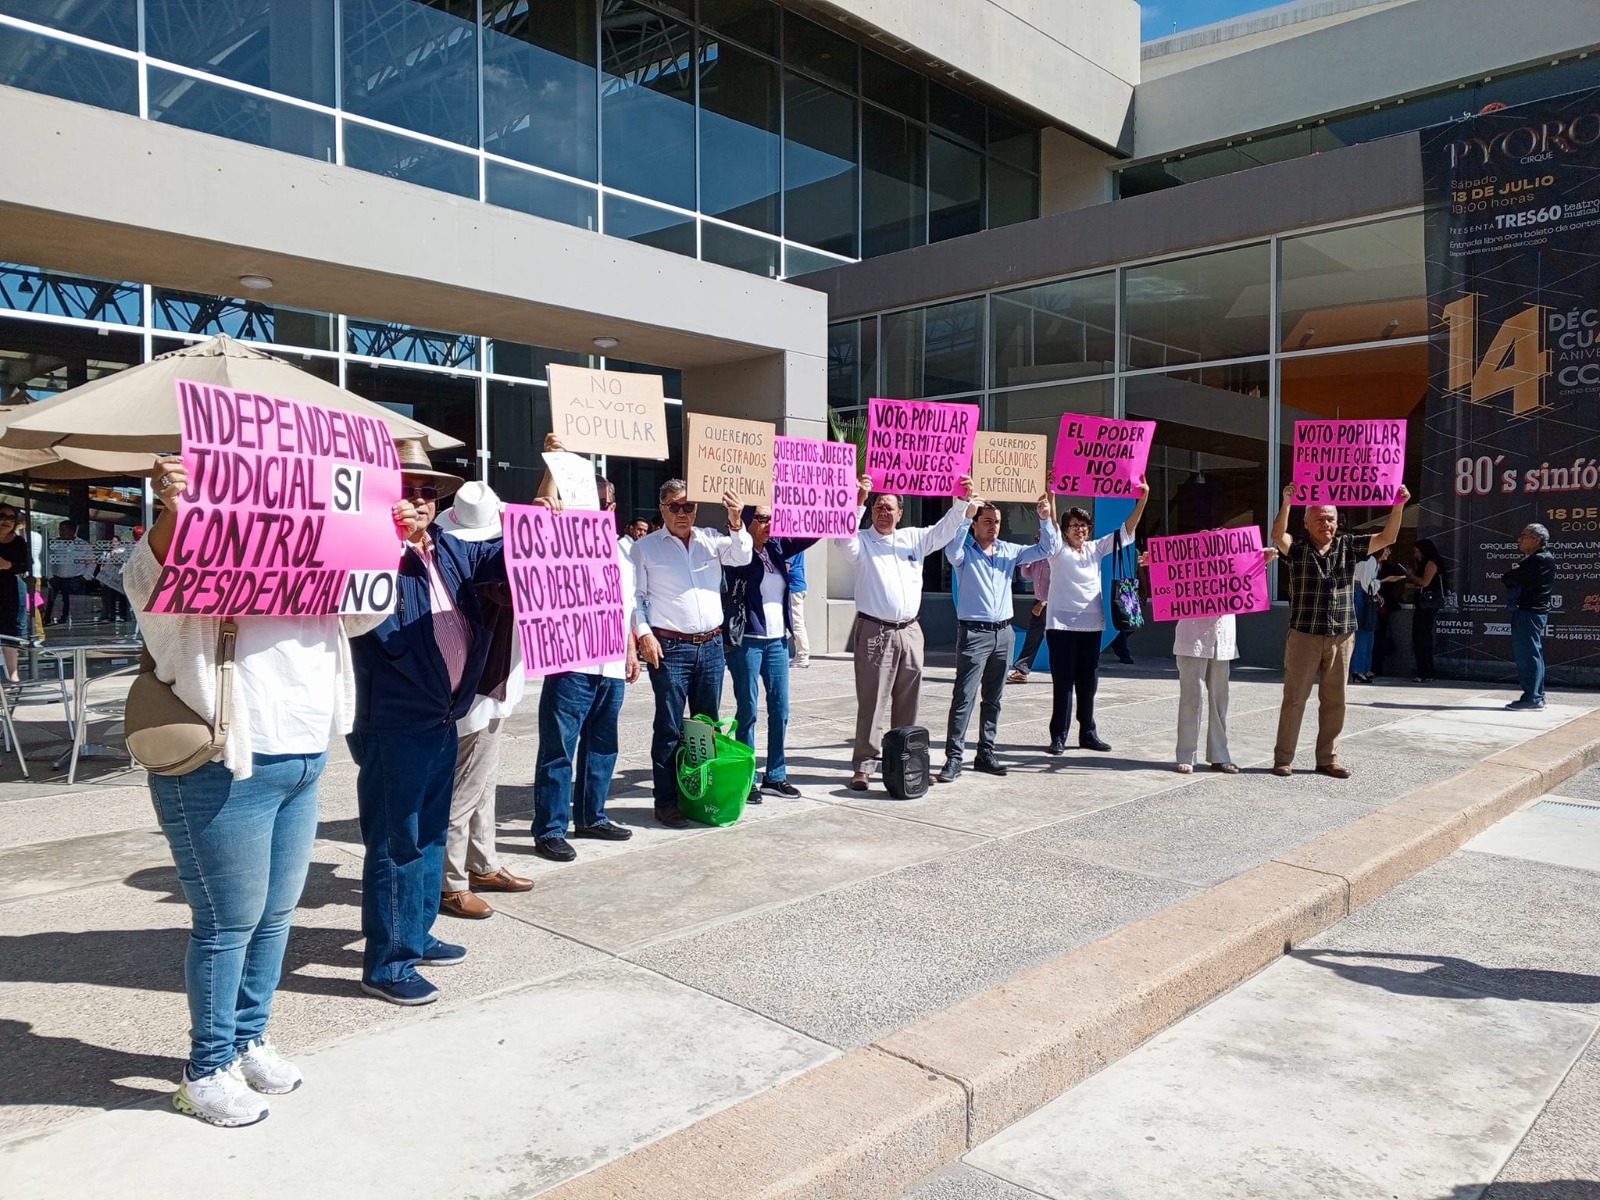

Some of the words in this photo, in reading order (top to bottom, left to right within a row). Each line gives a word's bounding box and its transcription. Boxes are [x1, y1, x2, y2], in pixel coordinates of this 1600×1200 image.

[1520, 152, 1554, 164] CIRQUE
[1451, 175, 1498, 189] Sábado
[1472, 186, 1494, 200] DE
[1499, 175, 1555, 194] JULIO
[1452, 202, 1487, 214] 19:00
[1491, 192, 1535, 208] horas
[1563, 206, 1600, 218] musical
[1450, 224, 1494, 235] PRESENTA
[1495, 205, 1562, 230] TRES60
[1563, 199, 1600, 212] teatro
[1450, 237, 1482, 248] Entrada
[1484, 234, 1503, 244] libre
[1504, 231, 1522, 240] con
[1556, 224, 1568, 232] de
[1558, 330, 1600, 350] CU
[1442, 294, 1546, 415] 14
[591, 376, 622, 394] NO
[570, 397, 594, 409] AL
[599, 400, 646, 414] VOTO
[179, 382, 399, 470] INDEPENDENCIA
[565, 414, 656, 442] POPULAR
[875, 404, 908, 430] VOTO
[911, 407, 968, 435] POPULAR
[704, 426, 763, 446] QUEREMOS
[872, 430, 892, 449] NO
[944, 436, 966, 454] QUE
[1068, 422, 1084, 438] EL
[1097, 425, 1144, 442] PODER
[1298, 424, 1333, 444] VOTO
[1337, 424, 1400, 446] POPULAR
[774, 440, 818, 463] QUEREMOS
[820, 443, 854, 466] JUECES
[989, 438, 1036, 450] QUEREMOS
[1074, 440, 1134, 459] JUDICIAL
[698, 444, 766, 468] MAGISTRADOS
[870, 451, 904, 472] HAYA
[978, 448, 1038, 469] LEGISLADORES
[1297, 447, 1350, 464] PERMITE
[1354, 448, 1372, 466] QUE
[1376, 448, 1400, 464] LOS
[720, 463, 742, 474] CON
[772, 464, 789, 483] QUE
[791, 464, 814, 486] VEAN
[816, 466, 834, 487] POR
[838, 468, 848, 487] EL
[994, 466, 1020, 476] CON
[1086, 460, 1116, 476] NO
[1315, 466, 1380, 483] JUECES
[1524, 458, 1600, 492] sinfó
[182, 447, 326, 511] JUDICIAL
[334, 468, 361, 511] SI
[702, 474, 766, 497] EXPERIENCIA
[884, 473, 954, 492] HONESTOS
[980, 477, 1037, 494] EXPERIENCIA
[1057, 476, 1080, 492] SE
[1092, 477, 1132, 494] TOCA
[774, 486, 816, 506] PUEBLO
[825, 489, 848, 508] NO
[1296, 485, 1320, 501] SE
[1328, 485, 1394, 501] VENDAN
[773, 508, 792, 534] POR
[804, 510, 857, 535] GOBIERNO
[1546, 508, 1568, 520] 18
[1572, 508, 1598, 518] DE
[510, 512, 546, 559] LOS
[550, 514, 612, 559] JUECES
[1562, 521, 1600, 532] 20:0
[174, 507, 326, 568] CONTROL
[1150, 541, 1164, 563] EL
[1165, 538, 1200, 562] PODER
[1202, 531, 1258, 558] JUDICIAL
[1480, 542, 1520, 550] ORQUES
[1486, 552, 1524, 560] Director
[1168, 558, 1236, 581] DEFIENDE
[1562, 563, 1592, 571] Grupo
[144, 566, 345, 615] PRESIDENCIAL
[340, 572, 394, 613] NO
[512, 565, 544, 614] NO
[546, 564, 593, 610] DEBEN
[593, 577, 604, 606] de
[603, 563, 624, 606] SER
[1154, 587, 1171, 596] LOS
[1175, 575, 1252, 598] DERECHOS
[1170, 593, 1254, 617] HUMANOS
[1463, 594, 1498, 603] UASLP
[518, 613, 574, 670] TITERES
